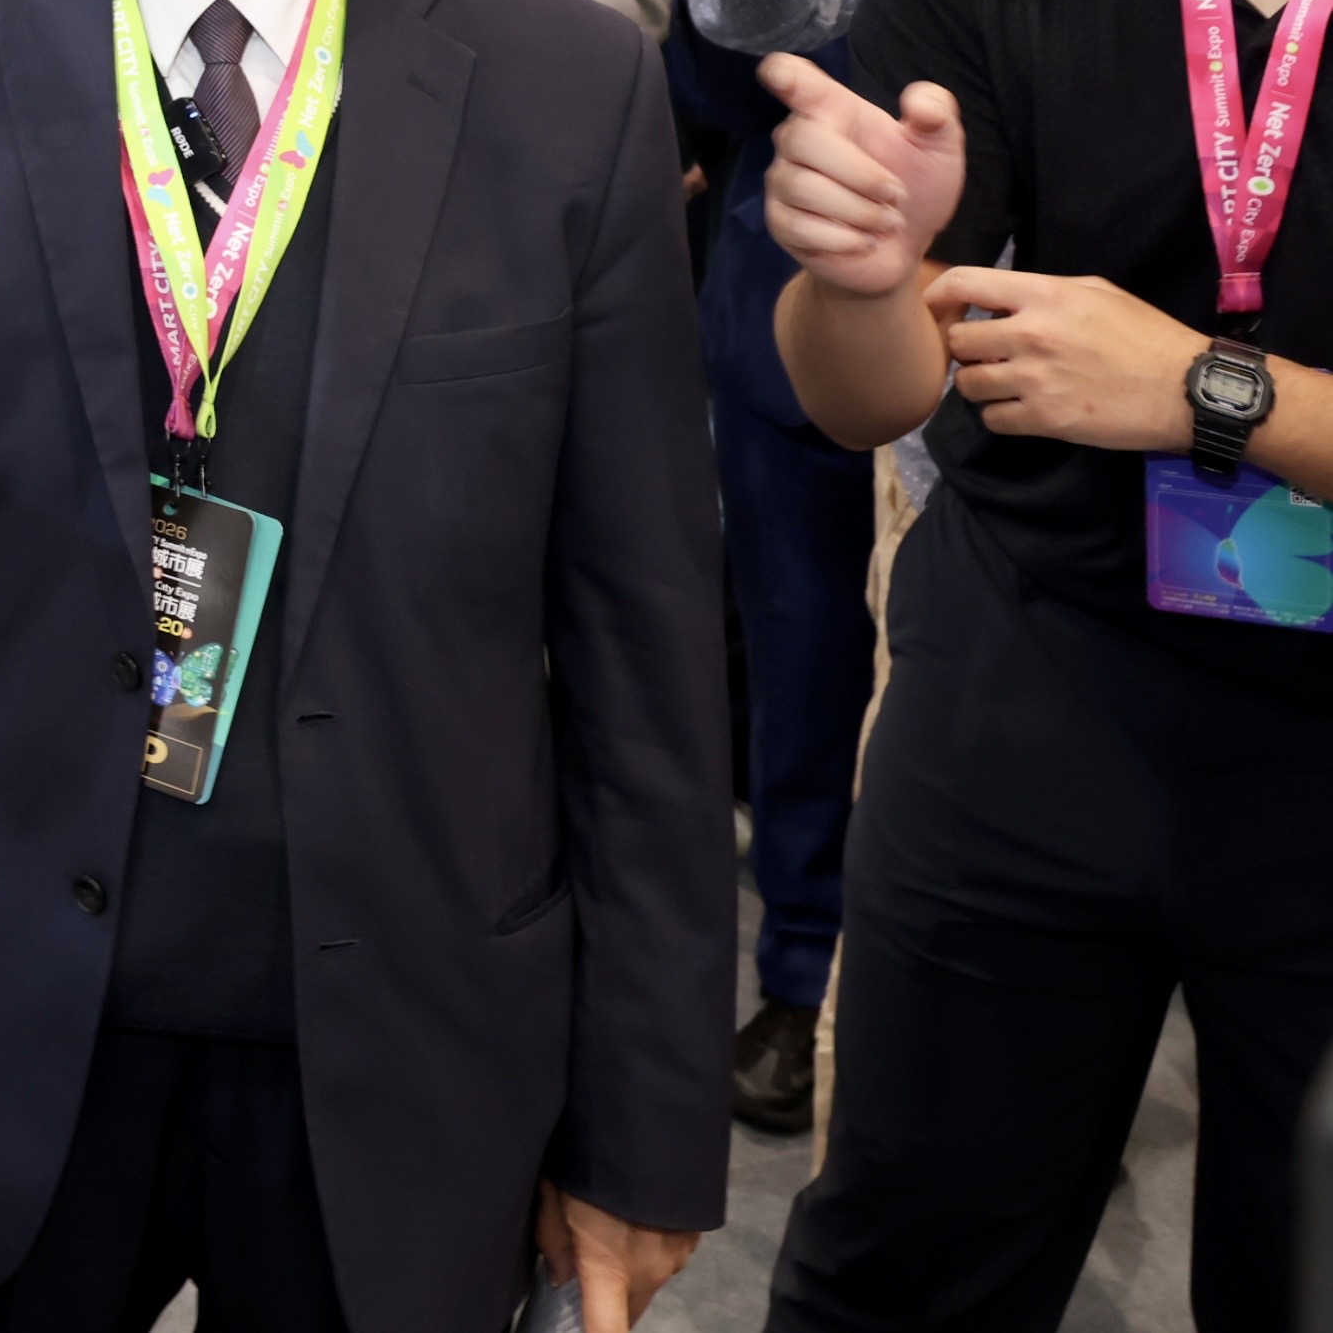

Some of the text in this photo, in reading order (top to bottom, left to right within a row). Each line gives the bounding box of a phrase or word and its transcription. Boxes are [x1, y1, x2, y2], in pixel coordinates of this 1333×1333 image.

[1207, 26, 1223, 61] Expo
[1277, 54, 1297, 87] Expo
[1210, 73, 1231, 128] Summit
[1263, 101, 1292, 140] Net
[117, 35, 140, 78] CITY
[142, 136, 159, 167] Expo
[166, 211, 186, 246] Net
[1213, 132, 1239, 182] CITY
[244, 176, 268, 209] Expo
[265, 210, 285, 259] Summit
[280, 171, 297, 200] Expo
[298, 95, 321, 129] Net
[1242, 197, 1263, 226] City
[222, 222, 254, 262] Net
[1235, 229, 1256, 263] Expo
[152, 518, 188, 540] 026
[152, 546, 205, 580] 城市展
[154, 580, 199, 602] City Expo
